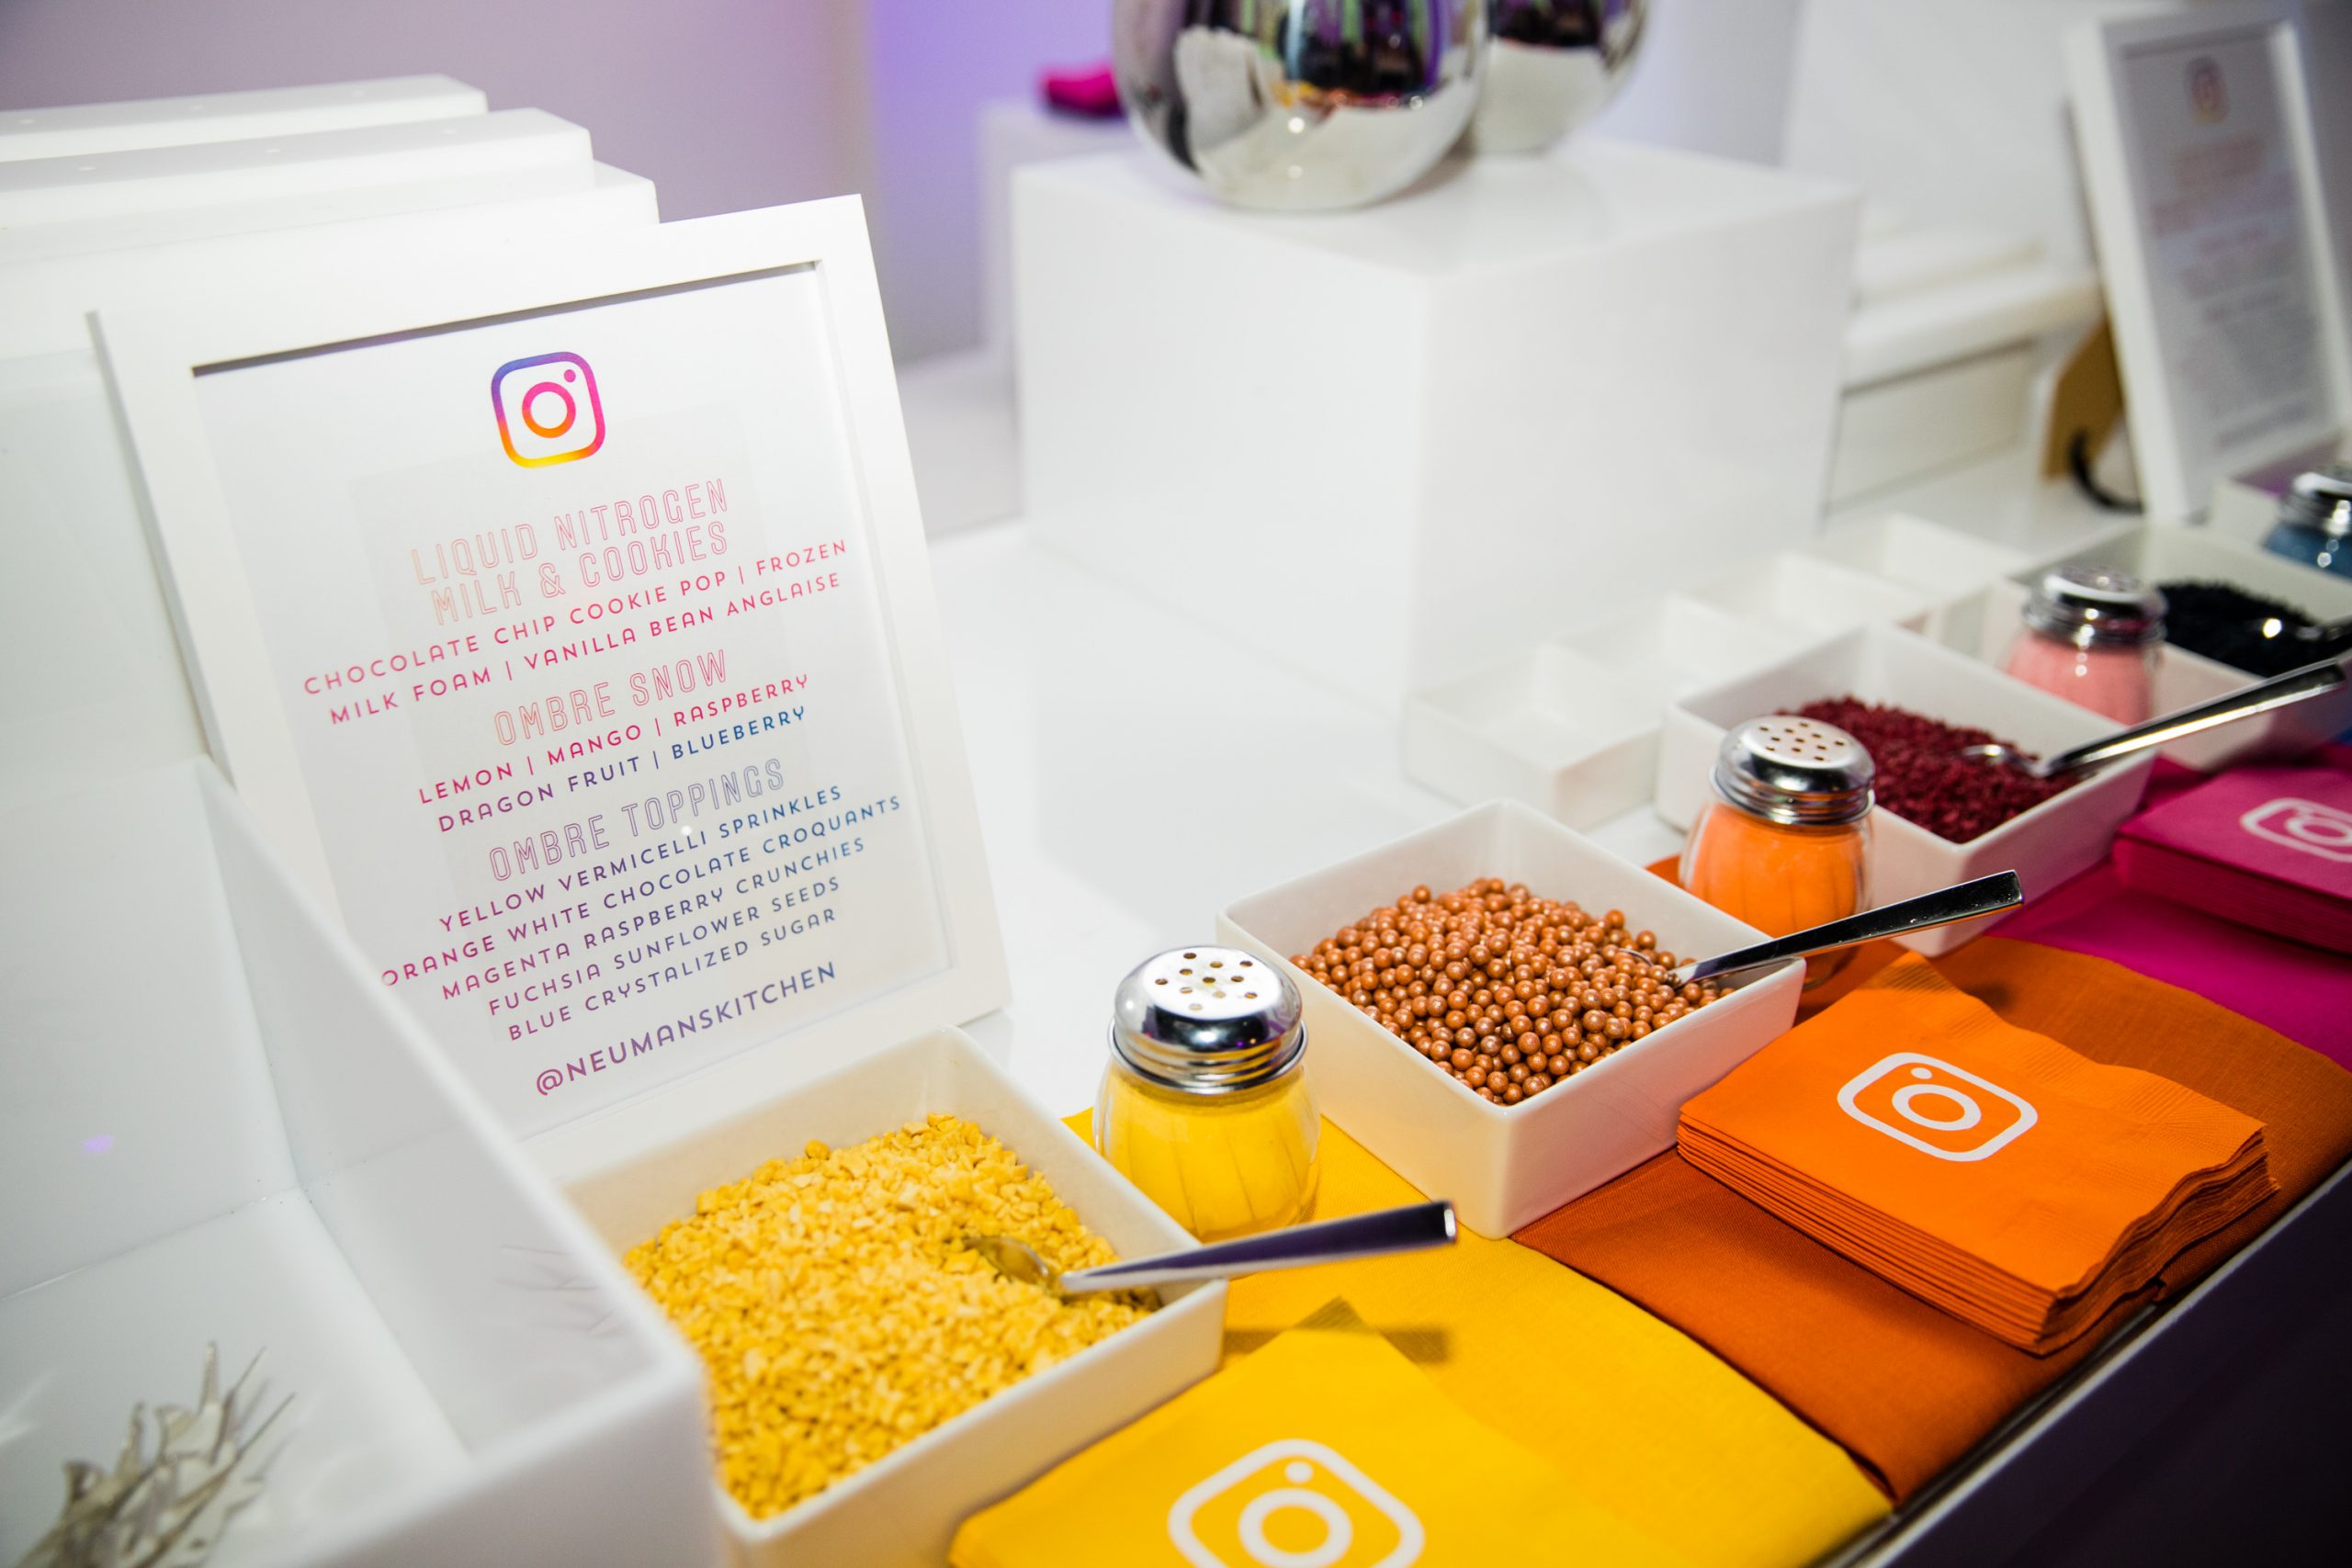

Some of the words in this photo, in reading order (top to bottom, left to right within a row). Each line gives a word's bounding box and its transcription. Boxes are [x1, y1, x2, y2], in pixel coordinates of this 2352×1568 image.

[413, 524, 537, 584] LIQUID
[554, 479, 727, 550] NITROGEN
[432, 571, 521, 625] MILK
[539, 563, 566, 598] &
[580, 522, 727, 587] COOKIES
[304, 635, 480, 694] CHOCOLATE
[494, 615, 555, 644] CHIP
[570, 586, 667, 625] COOKIE
[680, 571, 725, 596] POP
[756, 539, 845, 576] FROZEN
[330, 692, 399, 725] MILK
[413, 667, 491, 702] FOAM
[524, 627, 636, 670] VANILLA
[650, 606, 713, 637] BEAN
[728, 572, 839, 616] ANGLAISE
[419, 762, 513, 804] LEMON
[547, 725, 641, 765] MANGO
[673, 674, 807, 727] RASPBERRY
[494, 682, 615, 745] OMBRE
[629, 649, 726, 706] SNOW
[438, 784, 554, 832] DRAGON
[568, 756, 639, 792] FRUIT
[672, 705, 804, 760] BLUEBERRY
[490, 815, 609, 881] OMBRE
[621, 759, 784, 837] TOPPINGS
[382, 935, 495, 986] ORANGE
[507, 902, 590, 942] WHITE
[604, 847, 750, 908] CHOCOLATE
[763, 795, 899, 853] CROQUANTS
[439, 884, 544, 932] YELLOW
[558, 830, 706, 891] VERMICELLI
[719, 785, 841, 839] SPRINKLES
[442, 942, 570, 999] MAGENTA
[583, 887, 722, 949] RASPBERRY
[736, 838, 864, 894] CRUNCHIES
[489, 964, 600, 1016] FUCHSIA
[614, 907, 760, 969] SUNFLOWER
[772, 876, 839, 912] SEEDS
[508, 1005, 571, 1041] BLUE
[585, 941, 748, 1011] CRYSTALIZED
[761, 908, 835, 946] SUGAR
[537, 961, 835, 1096] @NEUMANSKITCHEN
